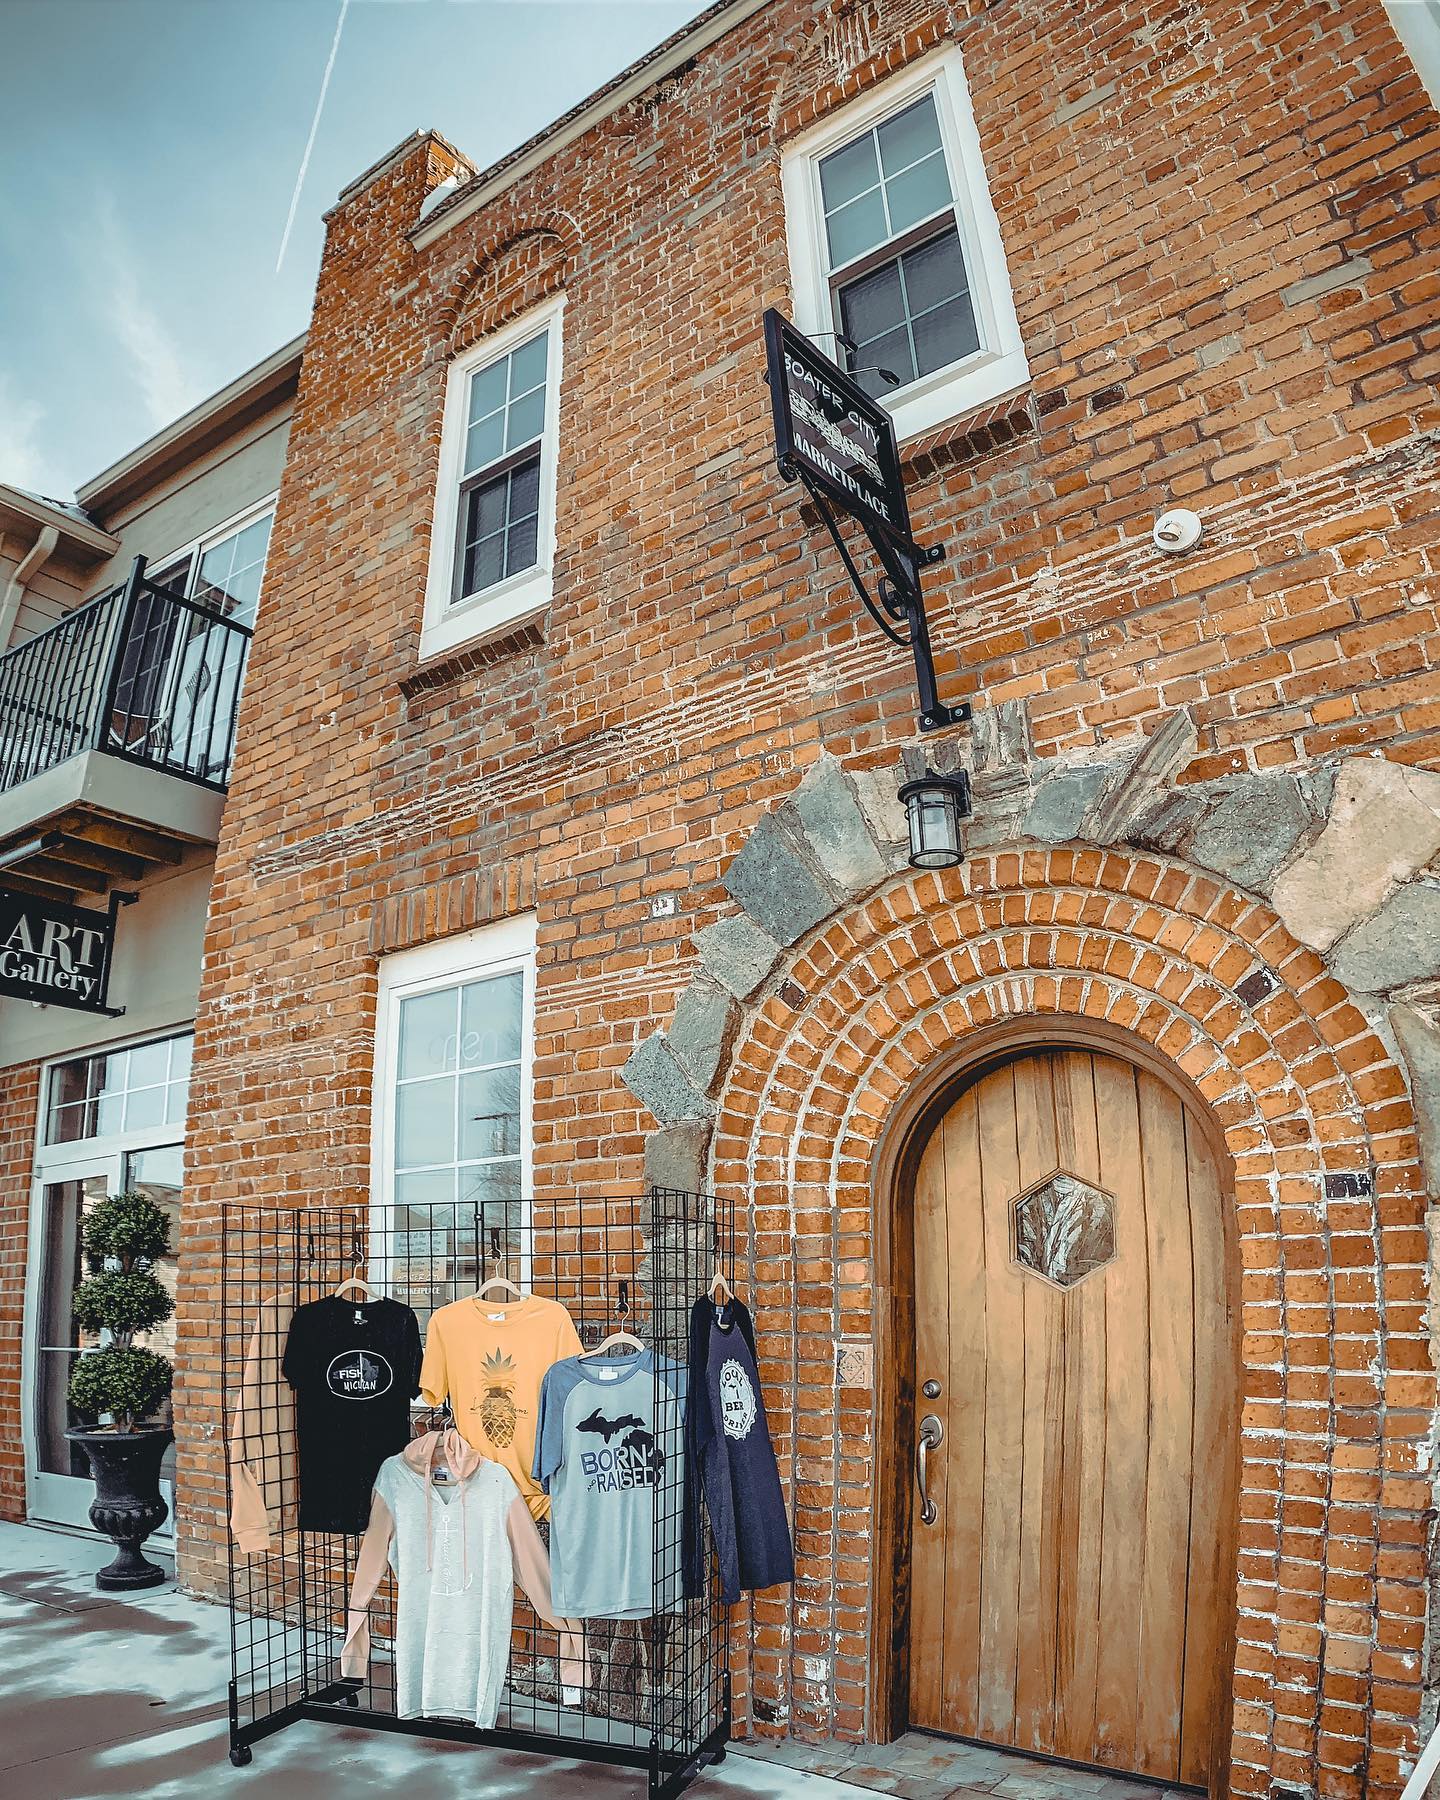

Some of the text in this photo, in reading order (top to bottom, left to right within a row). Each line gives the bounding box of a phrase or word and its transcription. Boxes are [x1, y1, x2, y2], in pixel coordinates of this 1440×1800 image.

[784, 351, 880, 450] BOATER CITY
[793, 431, 891, 523] MARKETPLACE
[0, 913, 104, 974] ART
[0, 950, 98, 1000] Gallery
[339, 1369, 362, 1379] FISH
[580, 1444, 647, 1475] BORN
[596, 1466, 654, 1493] RAISED
